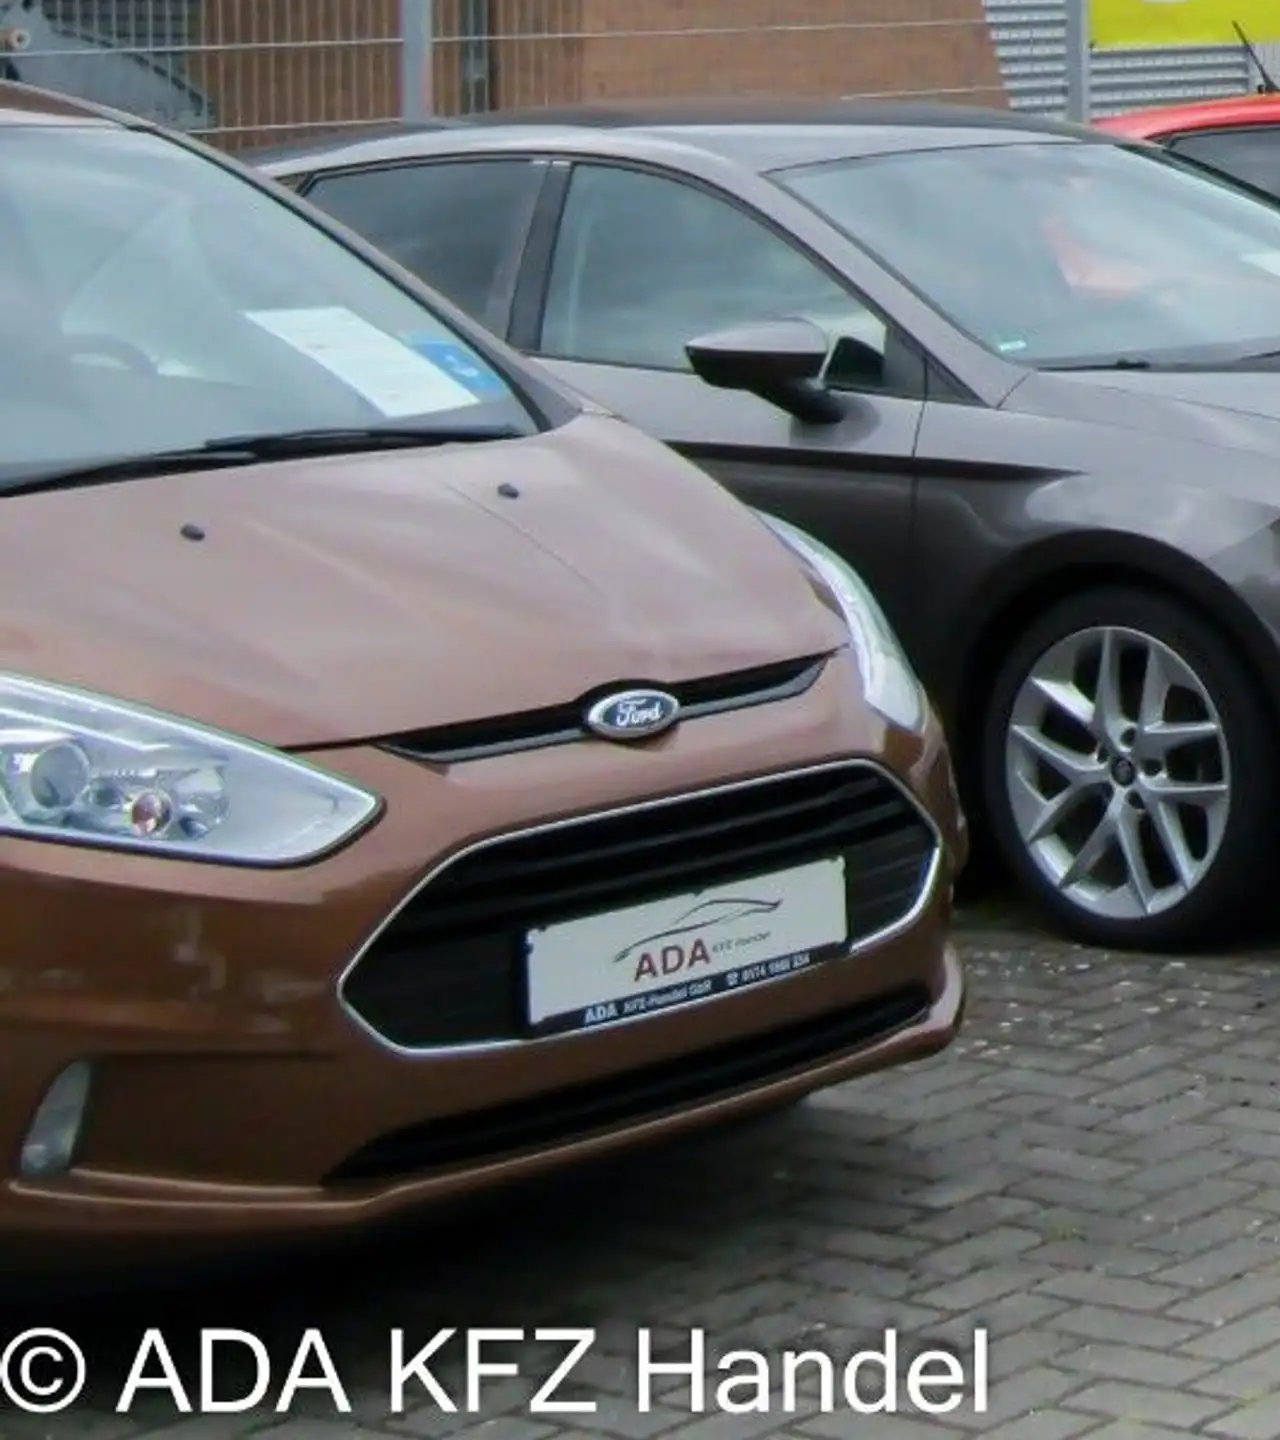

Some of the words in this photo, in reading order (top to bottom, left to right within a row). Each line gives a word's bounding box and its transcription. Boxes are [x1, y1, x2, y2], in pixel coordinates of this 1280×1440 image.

[616, 698, 664, 727] Ford
[633, 937, 712, 983] ADA
[584, 1002, 619, 1025] ADA
